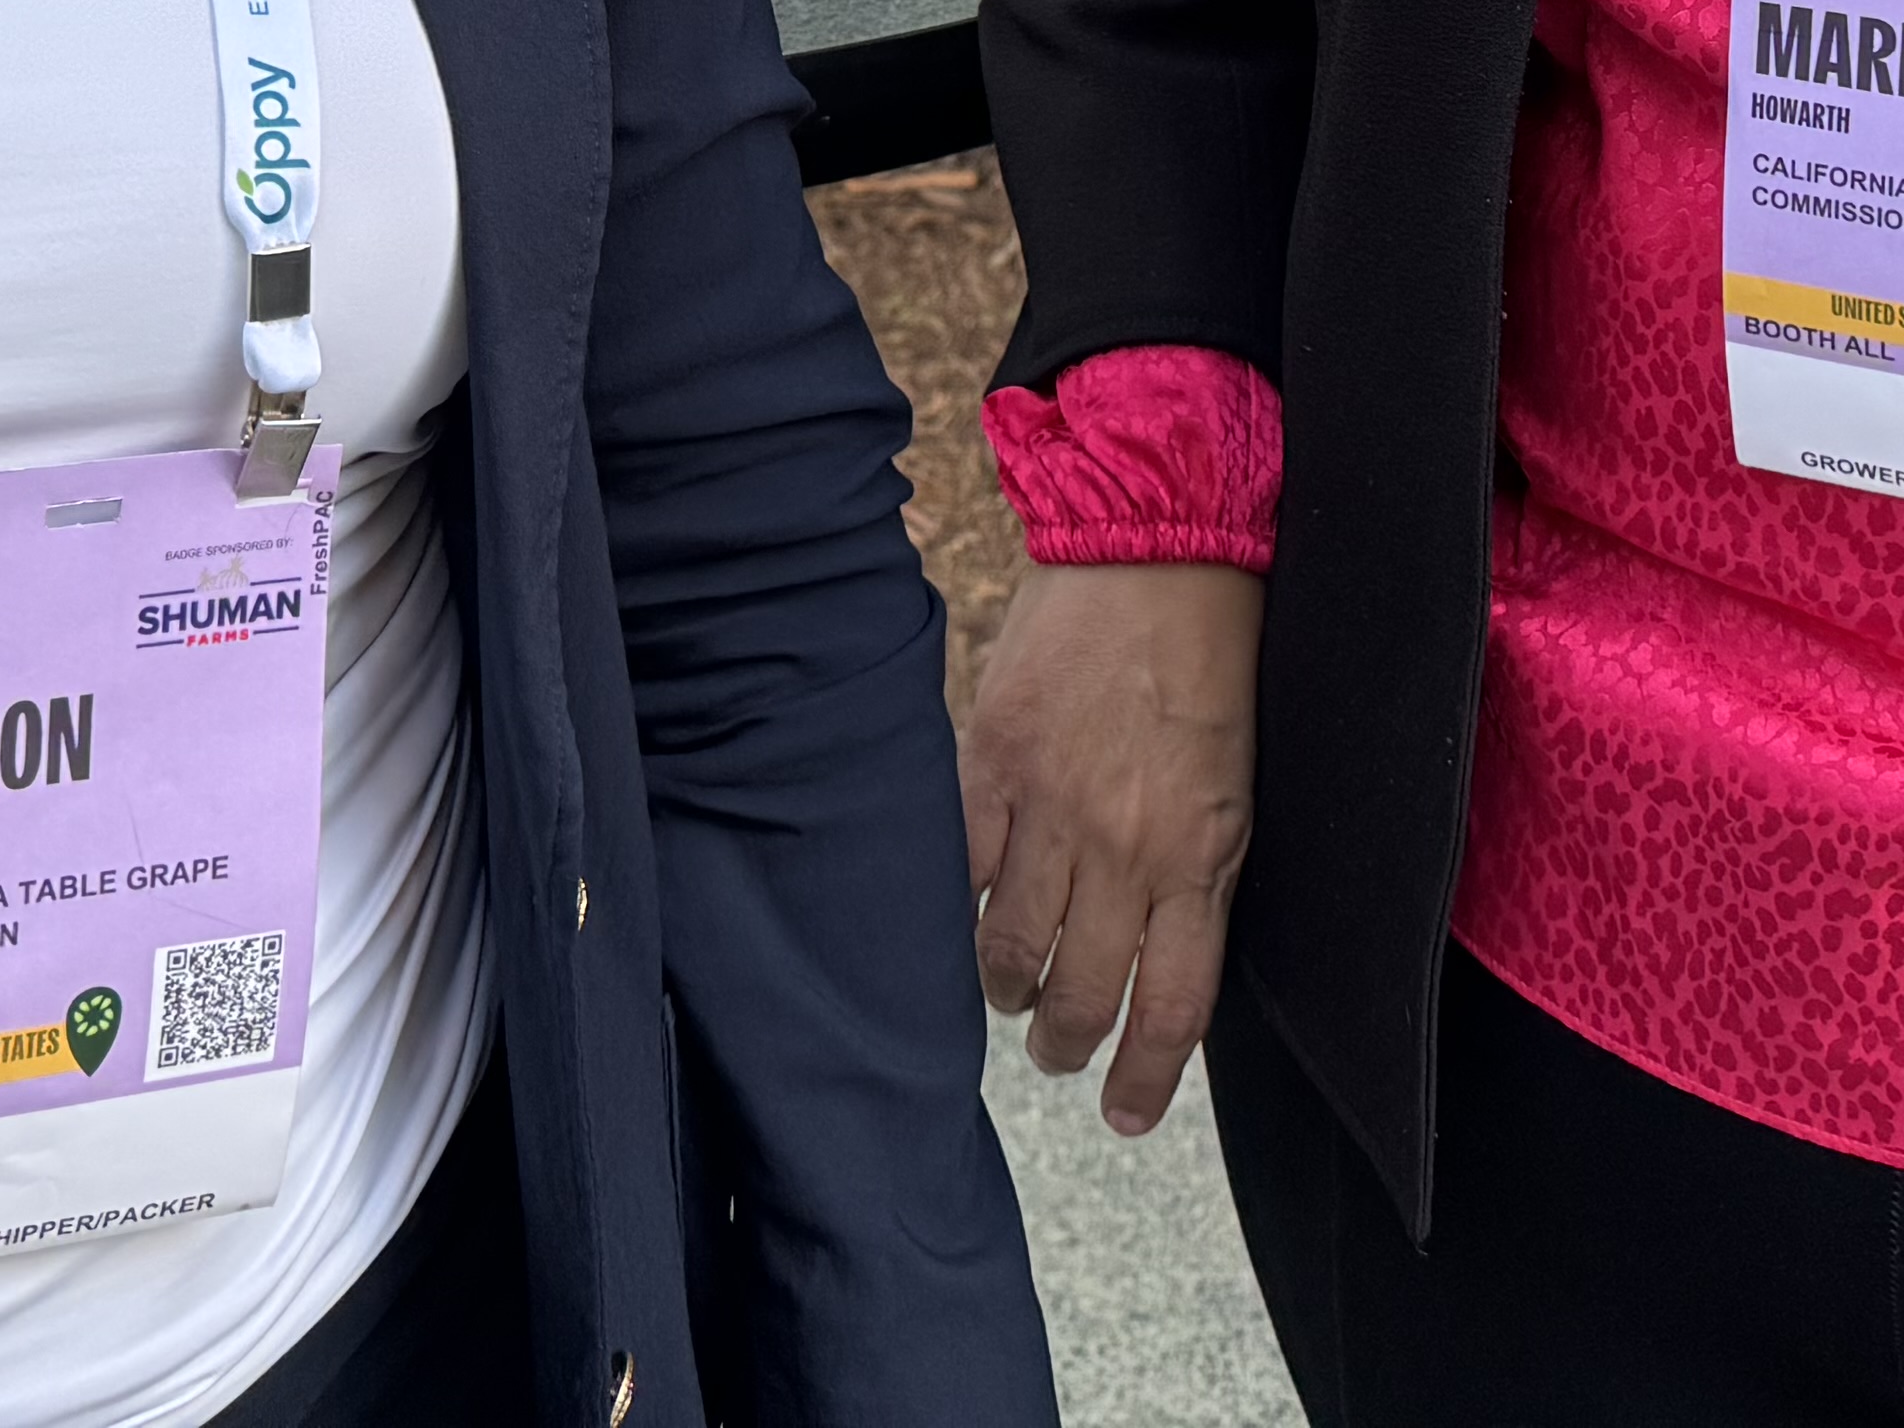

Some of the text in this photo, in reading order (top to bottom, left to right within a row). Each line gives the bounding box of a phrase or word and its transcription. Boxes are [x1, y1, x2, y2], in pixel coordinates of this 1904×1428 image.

[1751, 92, 1851, 134] HOWARTH
[240, 57, 311, 225] Oppy
[1831, 293, 1895, 327] UNITED
[1744, 315, 1896, 362] BOOTH ALL
[165, 547, 203, 562] BADGE
[205, 541, 274, 558] SPONSORED
[309, 489, 334, 598] FreshPAC
[137, 589, 302, 636] SHUMAN
[186, 630, 250, 646] FARMS
[19, 869, 117, 907] TABLE
[127, 855, 230, 891] GRAPE
